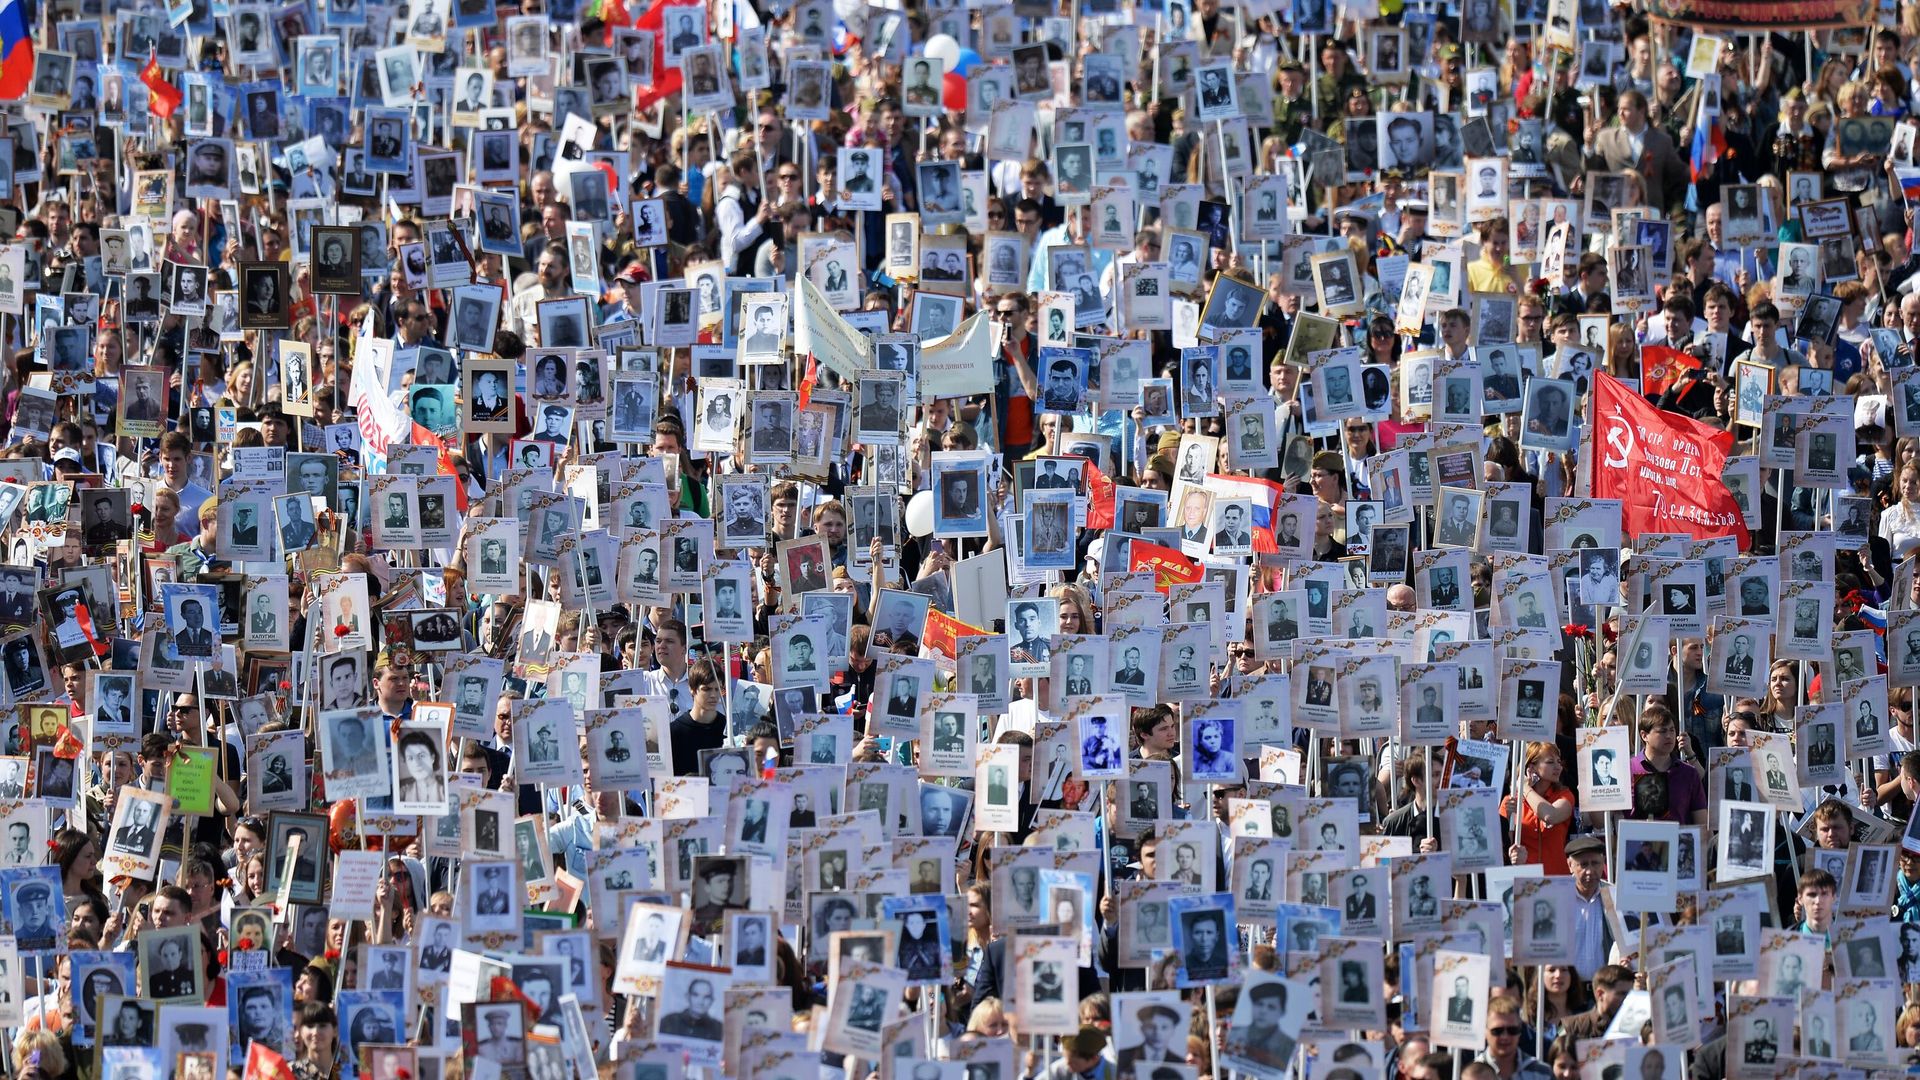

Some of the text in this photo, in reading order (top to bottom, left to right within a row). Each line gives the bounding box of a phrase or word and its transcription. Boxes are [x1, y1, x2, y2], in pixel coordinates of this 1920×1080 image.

[1673, 439, 1701, 457] ОРДЕН
[1150, 556, 1193, 577] 9 МАЯ
